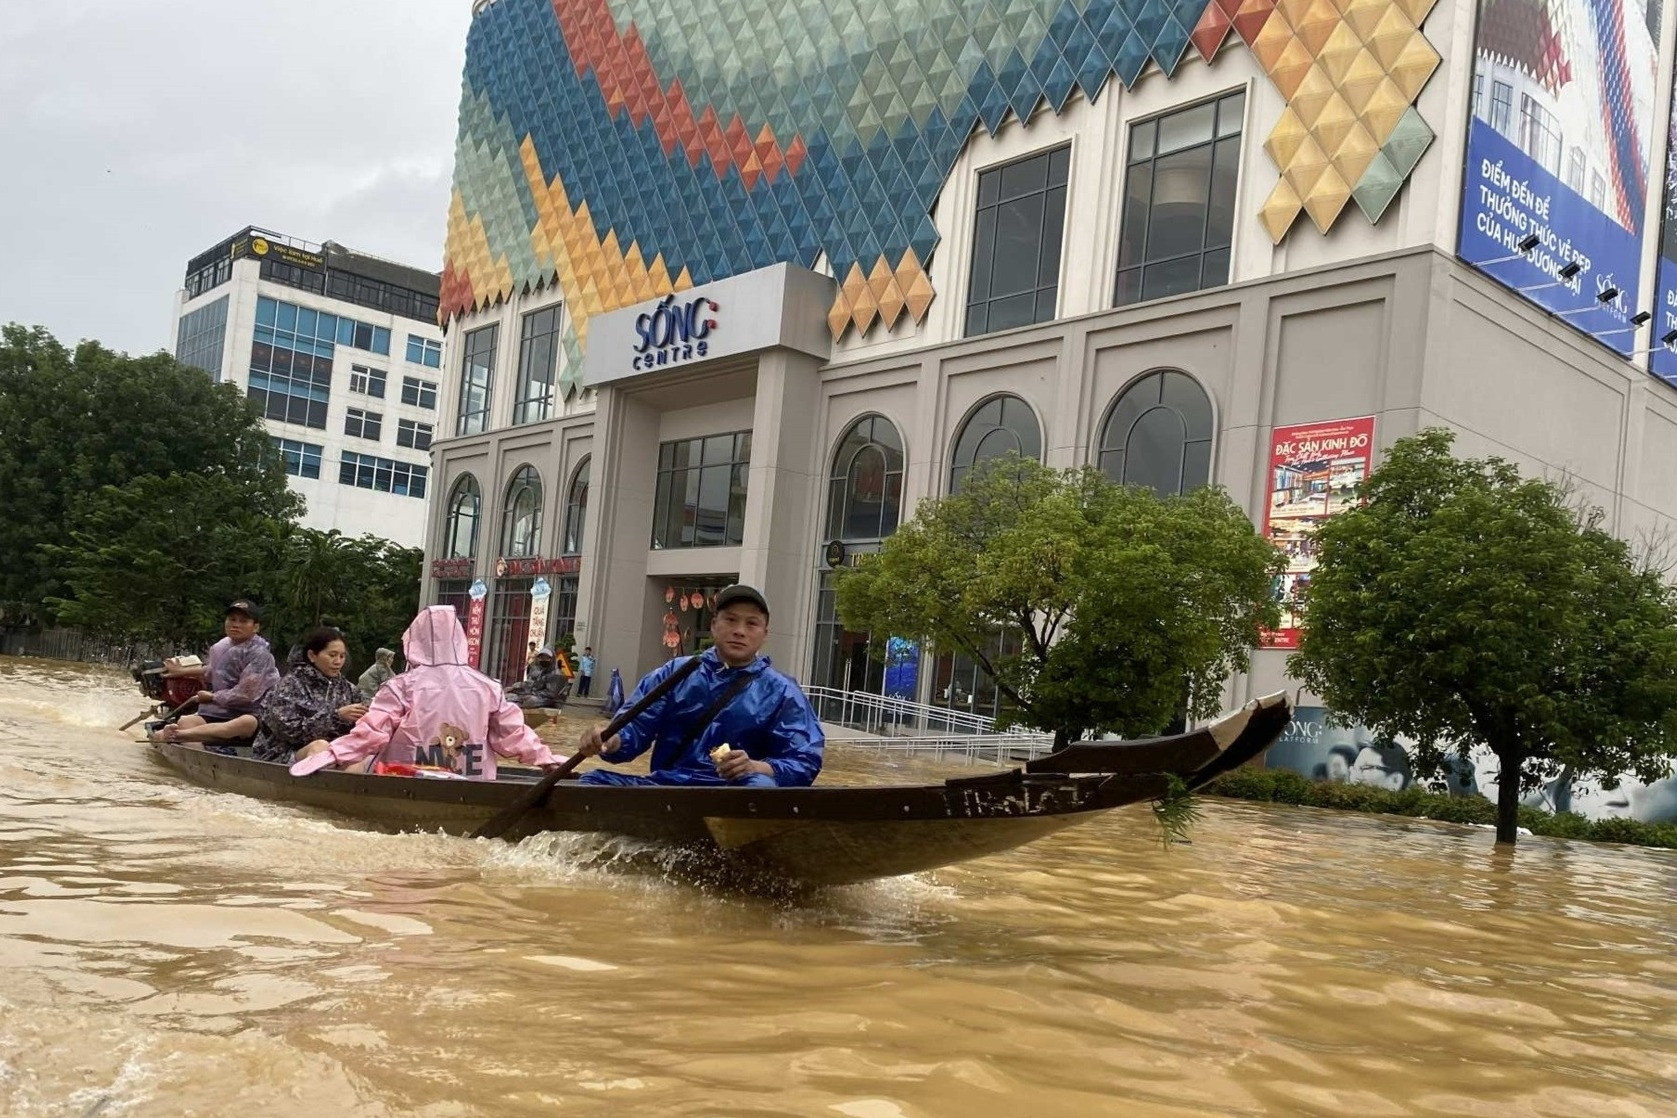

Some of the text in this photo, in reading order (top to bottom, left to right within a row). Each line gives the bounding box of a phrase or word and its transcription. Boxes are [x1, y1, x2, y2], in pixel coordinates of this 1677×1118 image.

[1481, 158, 1552, 221] ĐIỂM ĐẾN ĐỂ
[1477, 212, 1502, 243] CỦA
[1503, 228, 1527, 257] HU
[1480, 185, 1528, 231] THƯỞNG
[1529, 220, 1557, 252] THỨC
[1558, 238, 1572, 262] VẺ
[633, 293, 719, 353] SỐNG
[1275, 440, 1297, 456] ĐẶC
[1298, 437, 1320, 453] SẢN
[1321, 437, 1347, 451] KINH
[1349, 433, 1369, 448] ĐÔ
[1278, 736, 1319, 744] LATFORM
[1284, 715, 1321, 738] ỐNG
